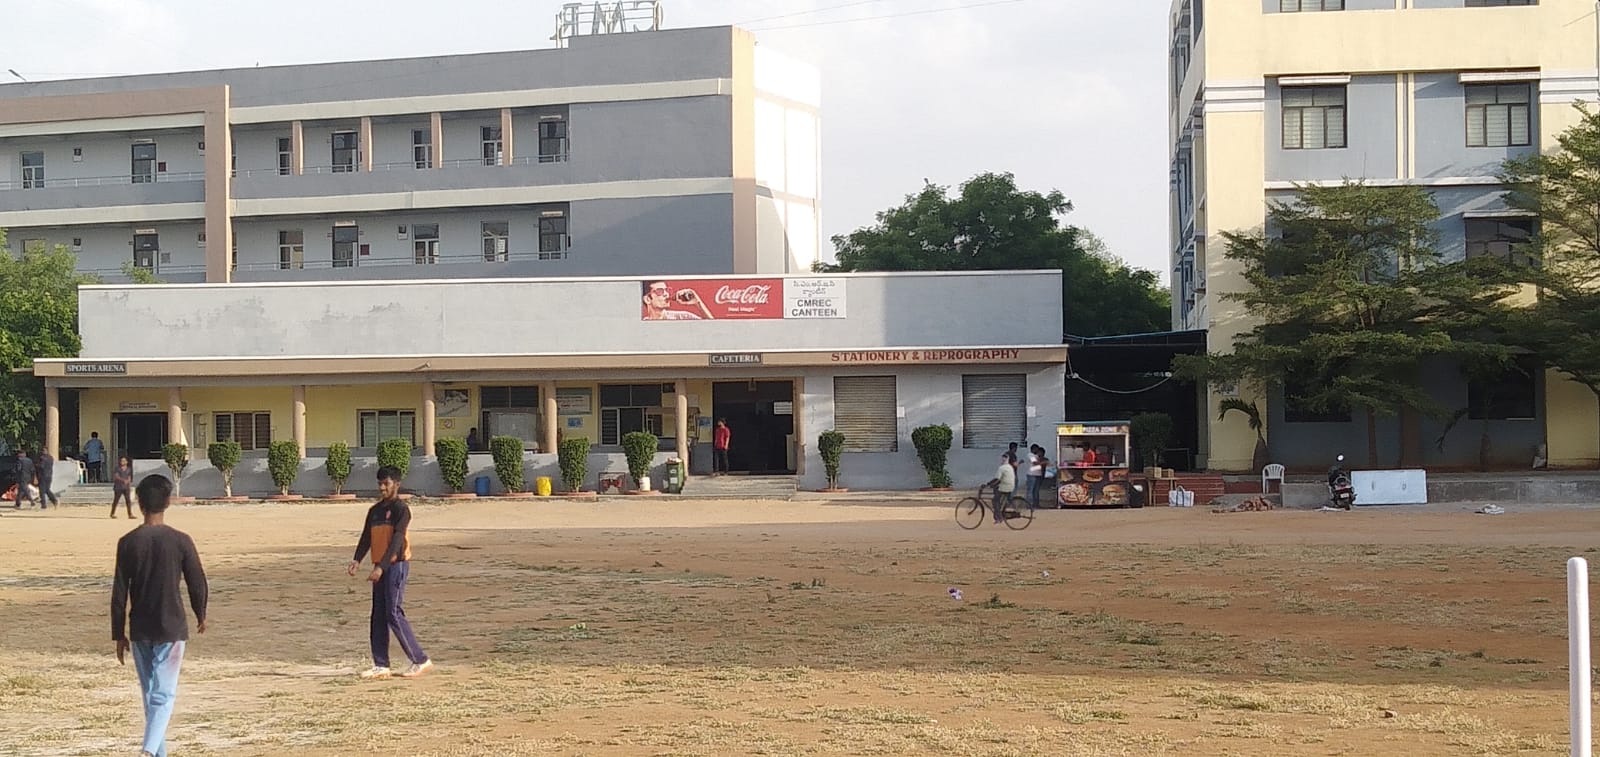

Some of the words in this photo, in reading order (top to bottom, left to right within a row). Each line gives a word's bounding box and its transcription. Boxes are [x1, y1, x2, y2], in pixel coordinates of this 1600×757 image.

[715, 284, 771, 304] Coca-Cola
[797, 299, 832, 307] CMREC
[791, 308, 837, 316] CANTEEN
[711, 354, 760, 364] CAFETERIA
[831, 350, 907, 362] STATIONERY
[912, 351, 920, 361] &
[923, 349, 1020, 361] REPROGRAPHY
[66, 364, 96, 372] SPORTS
[97, 364, 124, 372] ARENA
